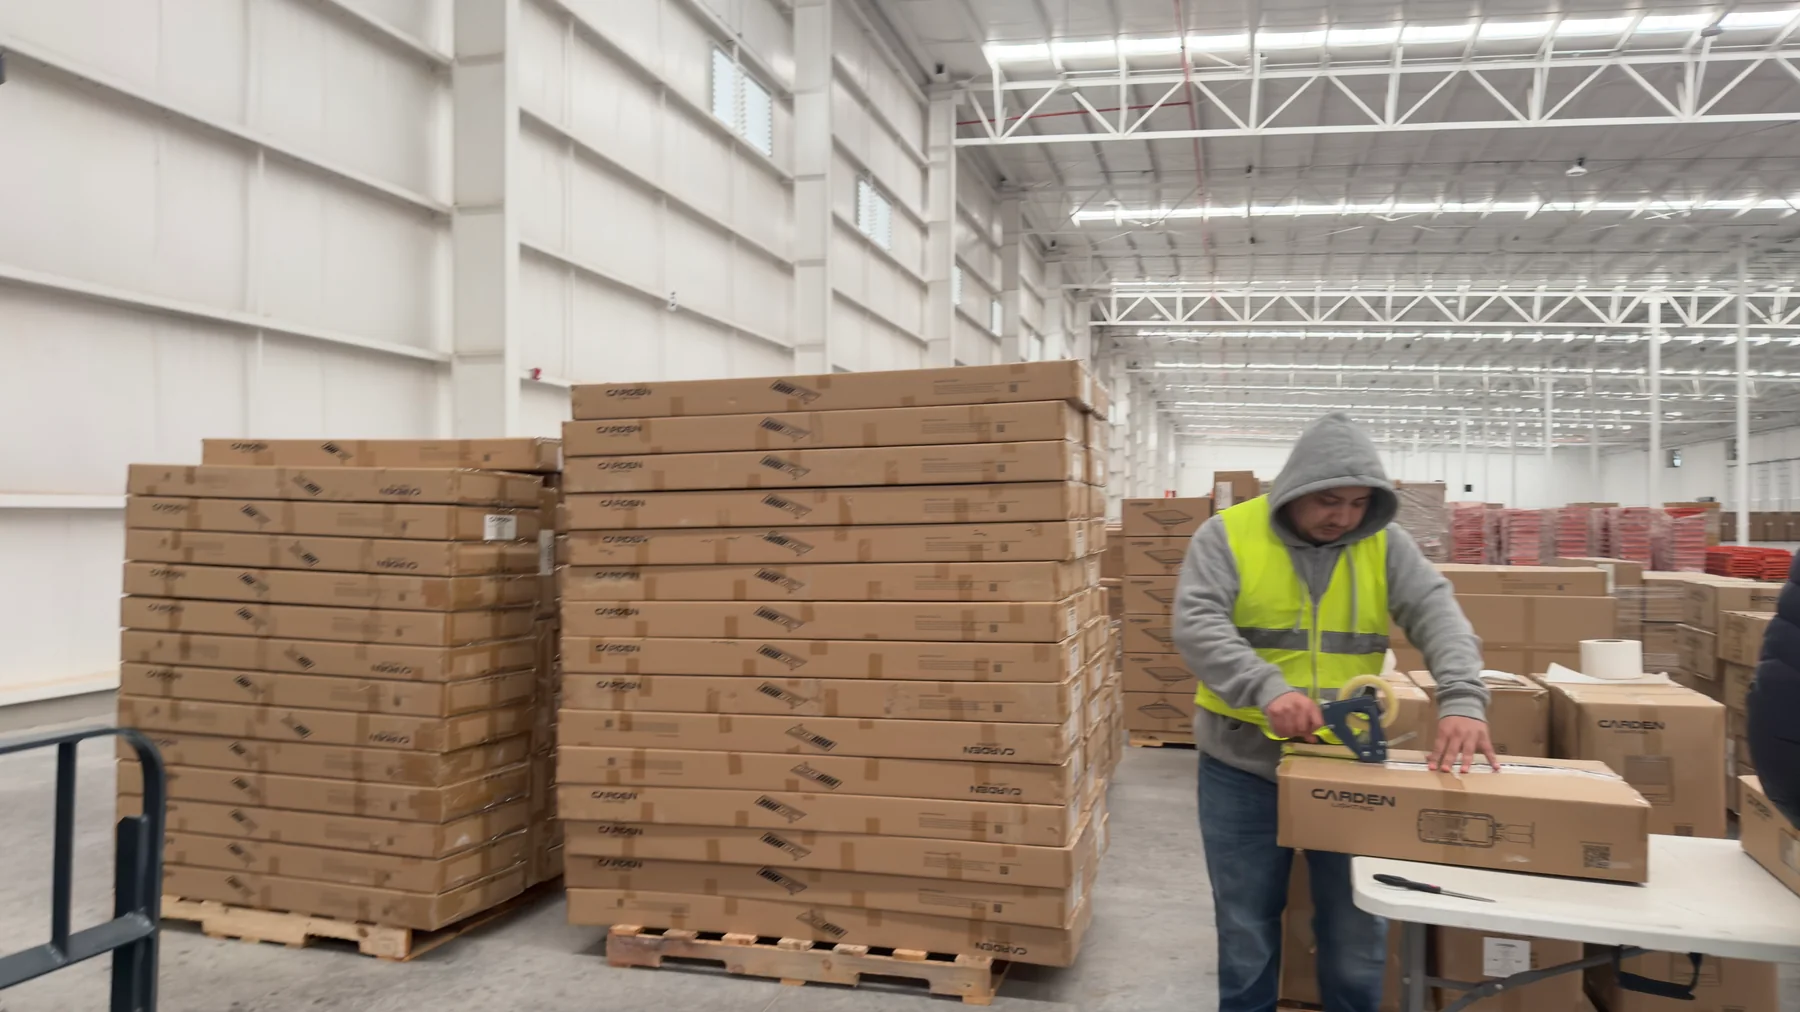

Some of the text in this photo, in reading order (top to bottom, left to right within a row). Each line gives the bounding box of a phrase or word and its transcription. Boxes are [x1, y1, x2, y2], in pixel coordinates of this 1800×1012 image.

[605, 388, 652, 398] CARDEN
[596, 425, 643, 435] CARDEN
[597, 461, 643, 471] CARDEN
[599, 498, 646, 508] CARDEN
[595, 643, 640, 653] CARDEN
[1597, 719, 1665, 730] CARDEN
[963, 746, 1015, 756] CARDEN
[591, 791, 638, 800] CARDEN
[969, 785, 1022, 796] CARDEN
[1311, 788, 1396, 807] CARDEN
[975, 941, 1028, 955] CARDEN
